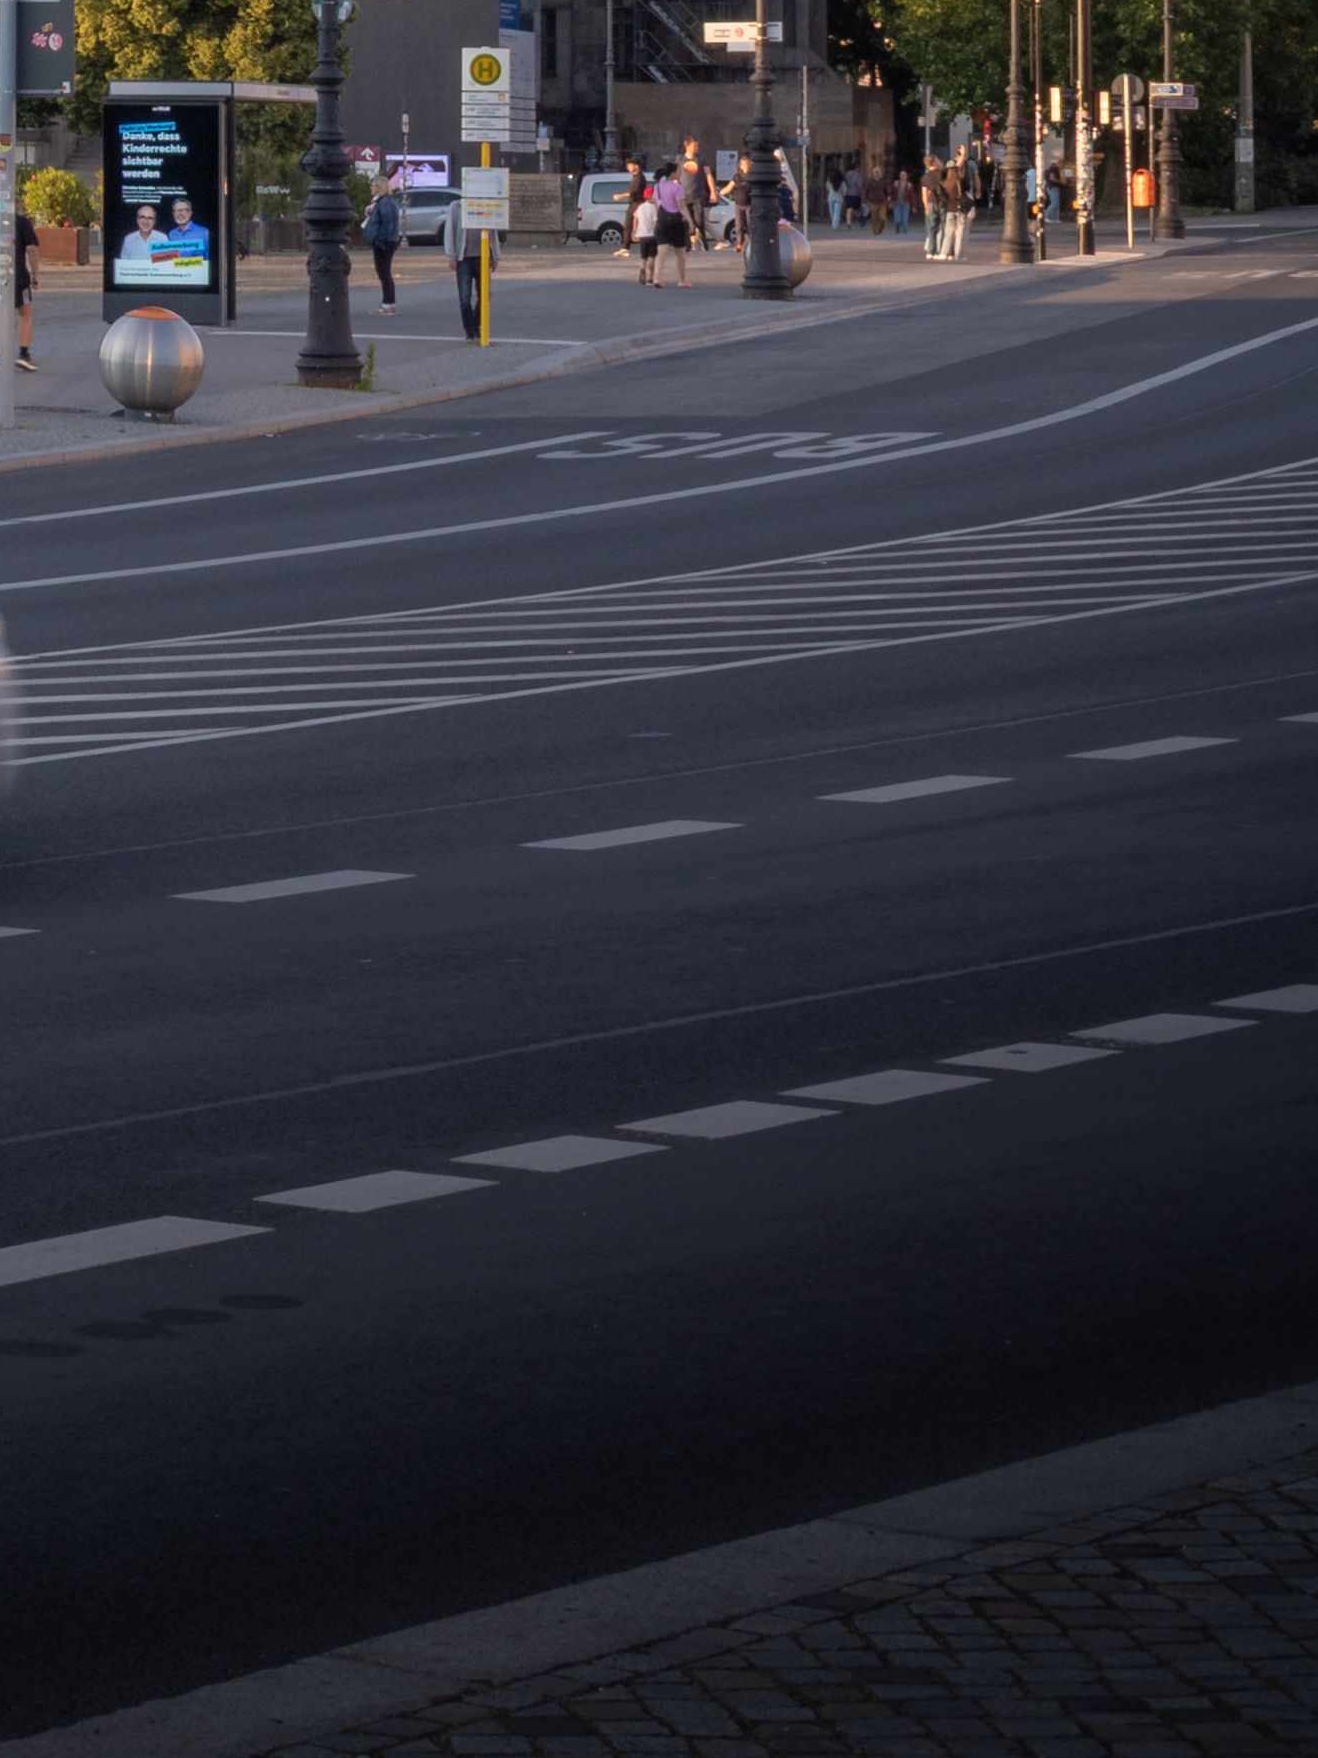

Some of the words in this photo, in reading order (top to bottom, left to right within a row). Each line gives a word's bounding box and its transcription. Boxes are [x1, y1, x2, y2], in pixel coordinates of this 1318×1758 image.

[478, 59, 494, 80] H
[122, 131, 156, 141] Danke,
[157, 131, 181, 141] dass
[122, 143, 188, 154] Kinderrechte
[122, 155, 164, 166] sichtbar
[122, 168, 161, 179] werden
[536, 431, 944, 459] BUS
